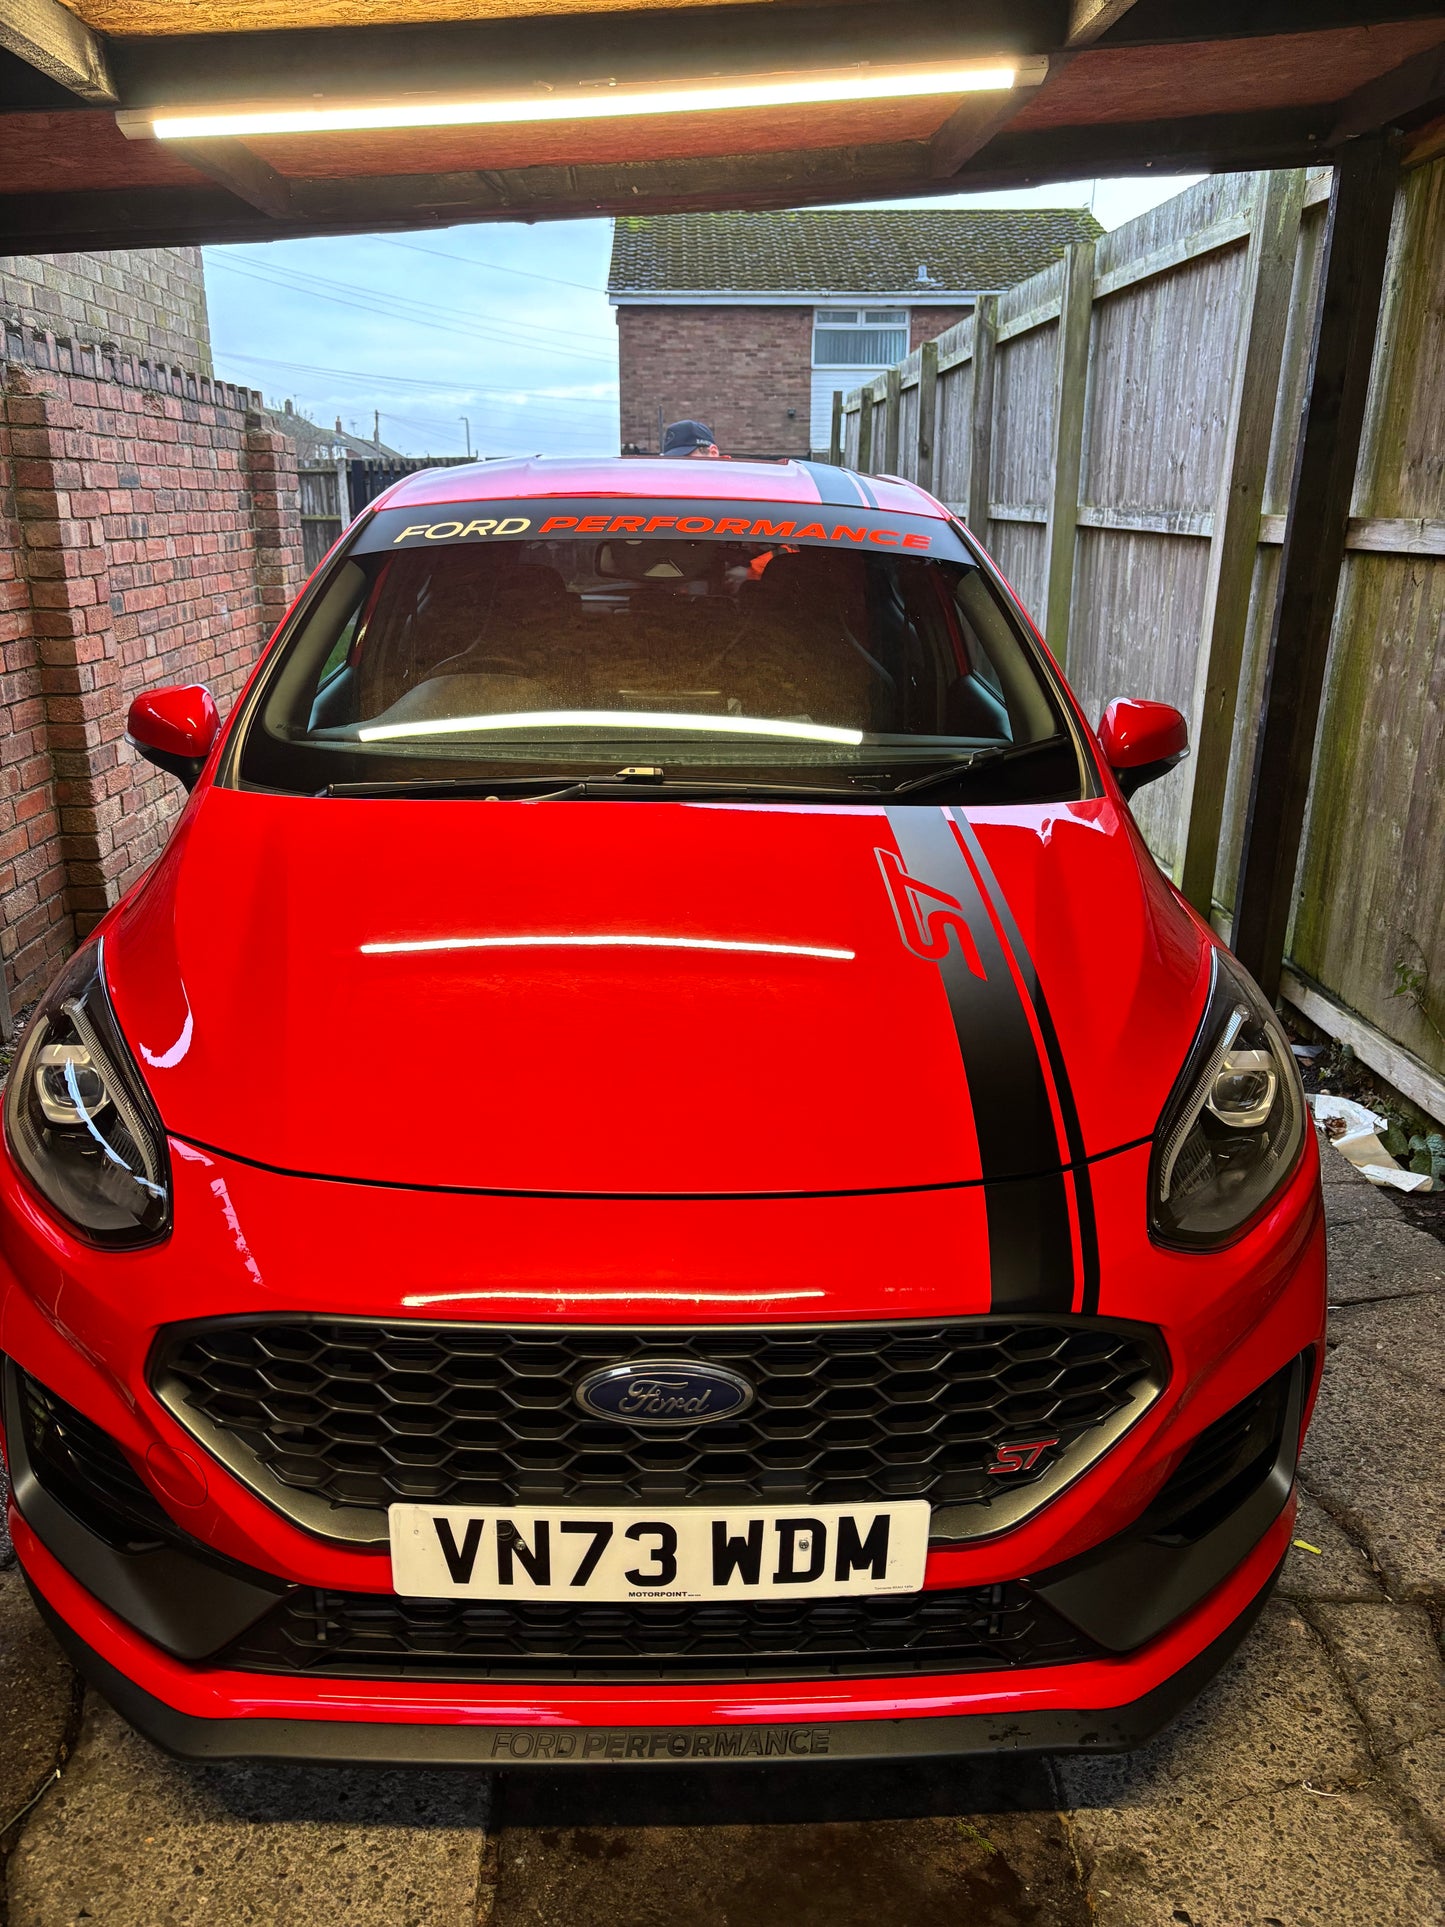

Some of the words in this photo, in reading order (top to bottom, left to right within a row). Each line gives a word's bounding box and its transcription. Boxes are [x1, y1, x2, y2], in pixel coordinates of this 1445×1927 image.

[394, 518, 532, 543] FORD
[538, 515, 934, 550] PERFORMANCE
[618, 1379, 713, 1414] Ford
[986, 1437, 1061, 1475] ST
[432, 1517, 678, 1588] VN73
[711, 1514, 891, 1586] WDM
[490, 1731, 578, 1759] FORD
[582, 1728, 832, 1759] PERFORMANCE
